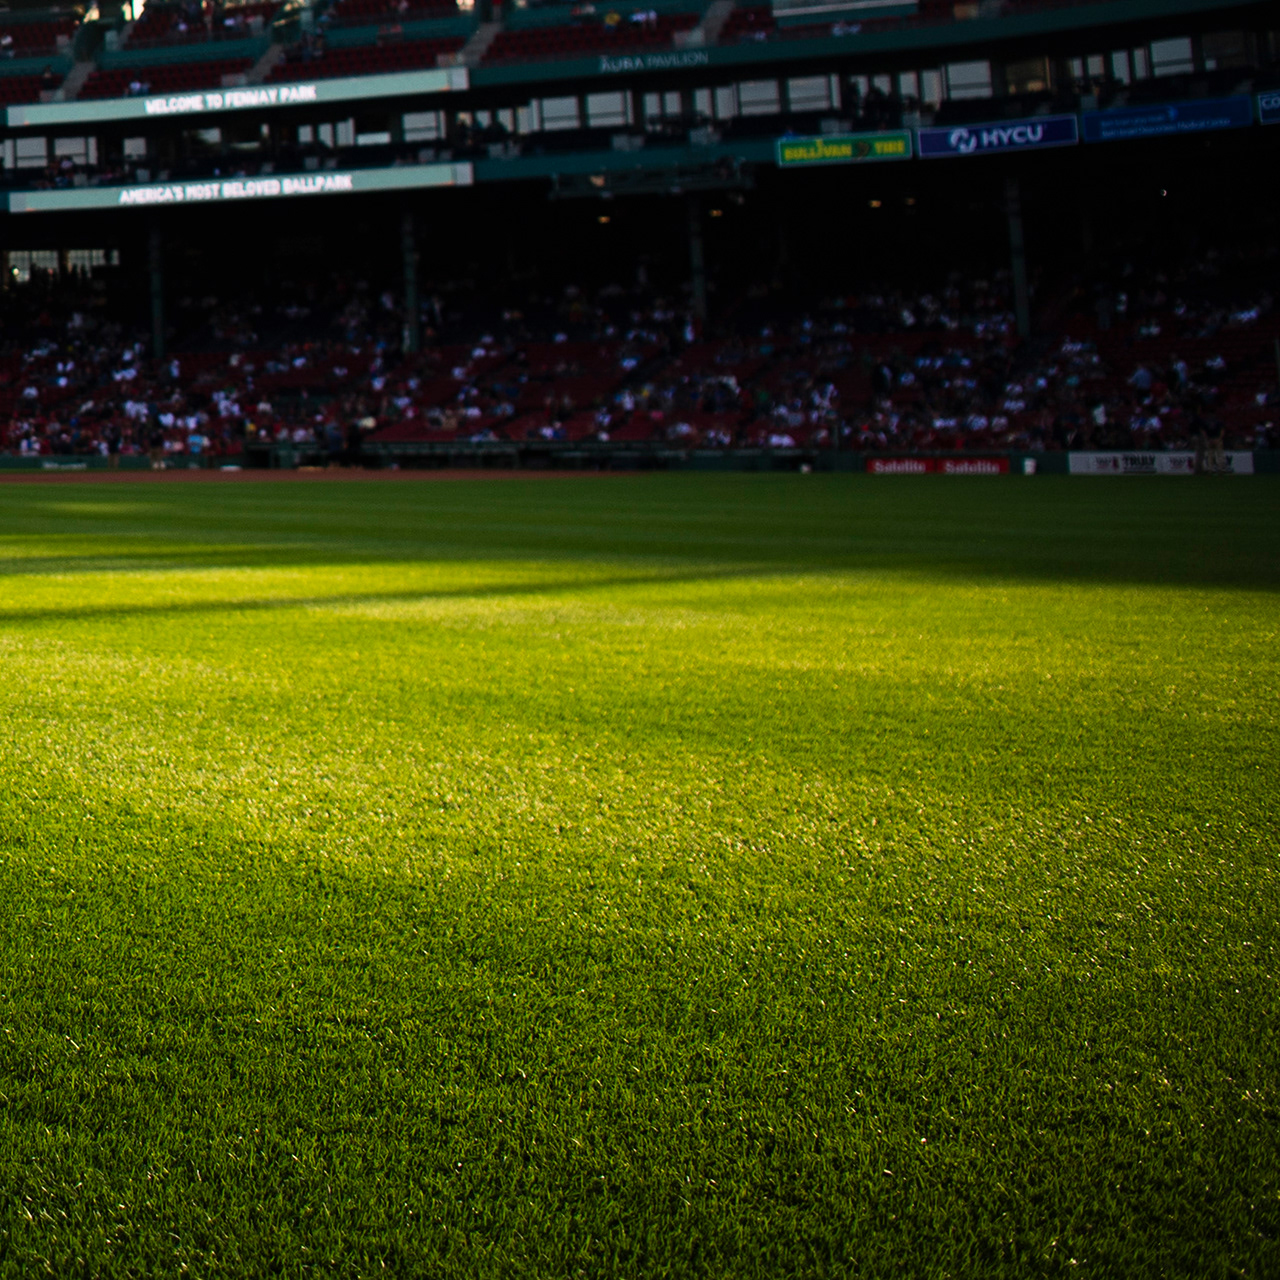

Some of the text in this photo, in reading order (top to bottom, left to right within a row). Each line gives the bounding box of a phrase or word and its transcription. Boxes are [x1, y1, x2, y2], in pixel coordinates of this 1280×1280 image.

[144, 85, 317, 114] WELCOME TO FENWAY PARK
[982, 123, 1043, 147] HYCU
[119, 174, 353, 205] AMERICA'S MOST BELOVED BALLPARK
